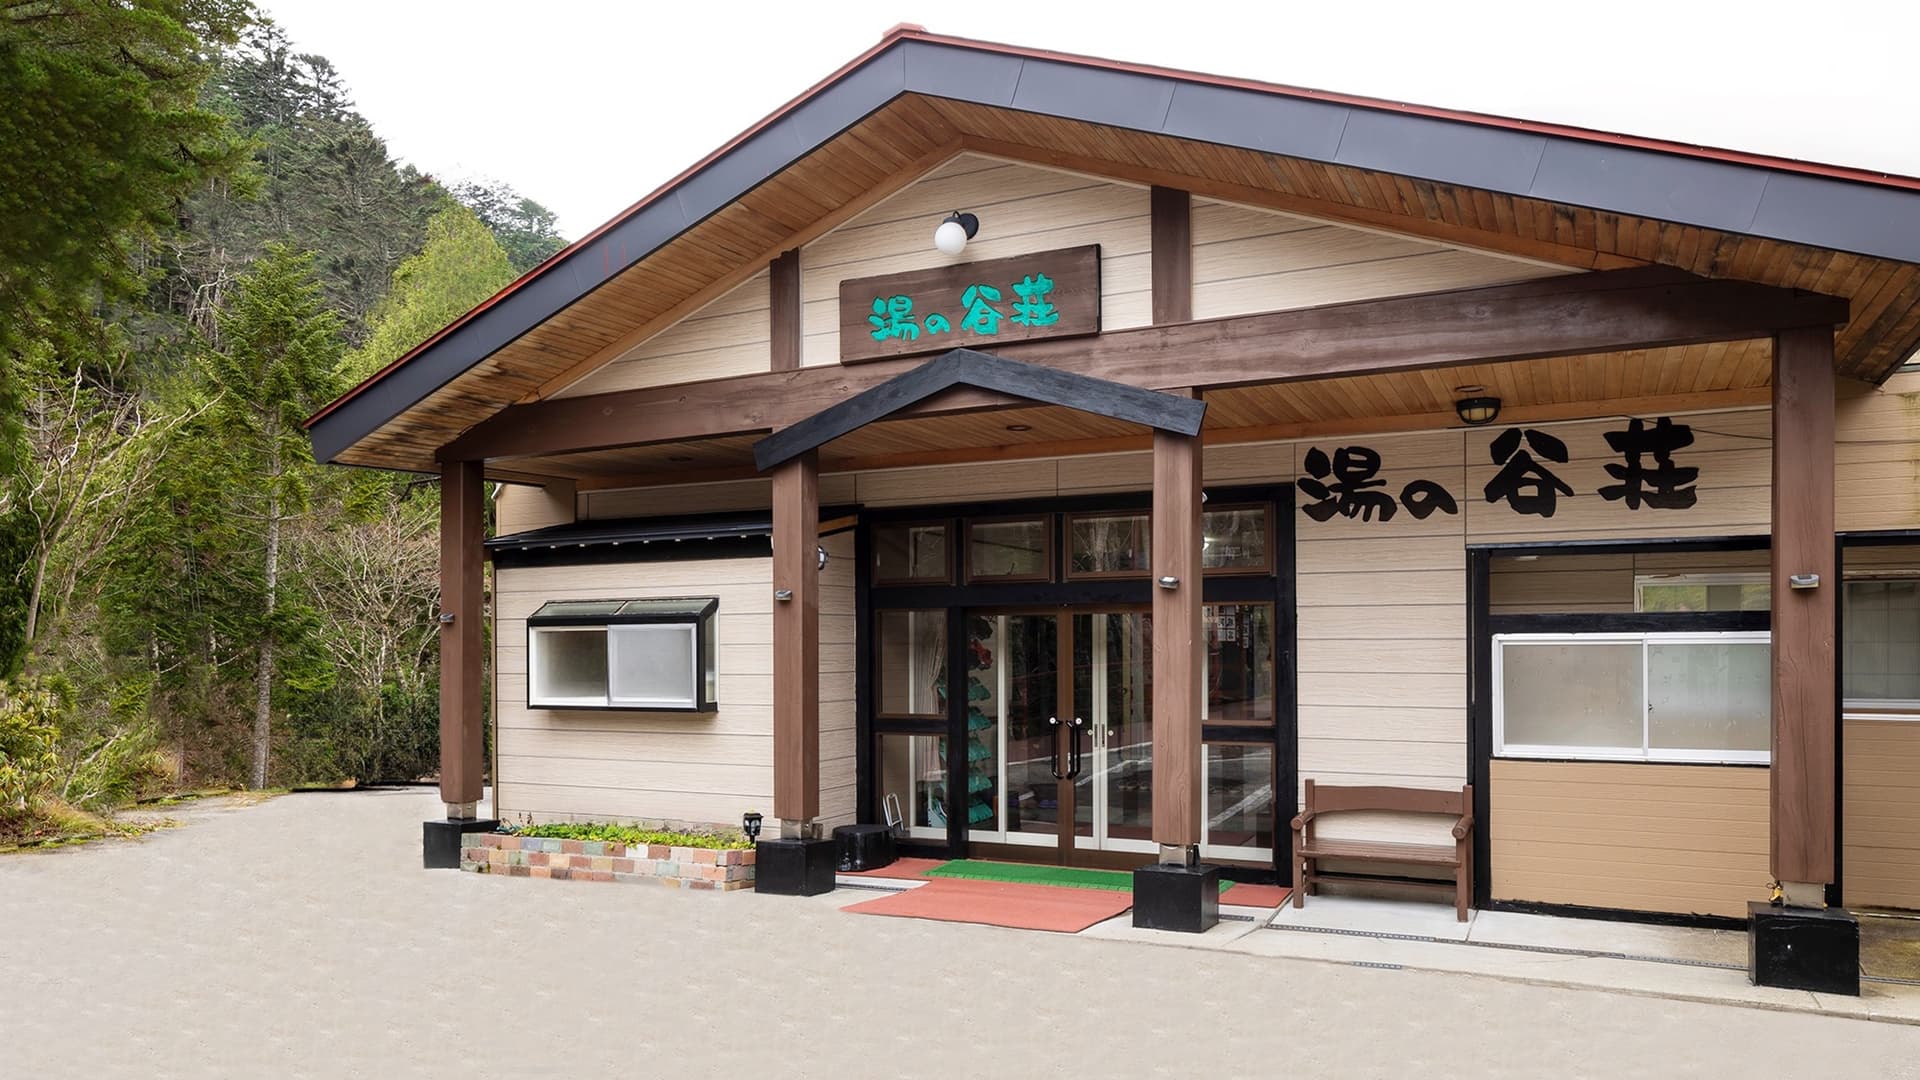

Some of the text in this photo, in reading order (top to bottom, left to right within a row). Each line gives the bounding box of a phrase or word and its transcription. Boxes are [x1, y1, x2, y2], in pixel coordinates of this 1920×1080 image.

[868, 272, 1060, 342] 湯の谷荘
[1297, 416, 1699, 522] 湯の谷荘
